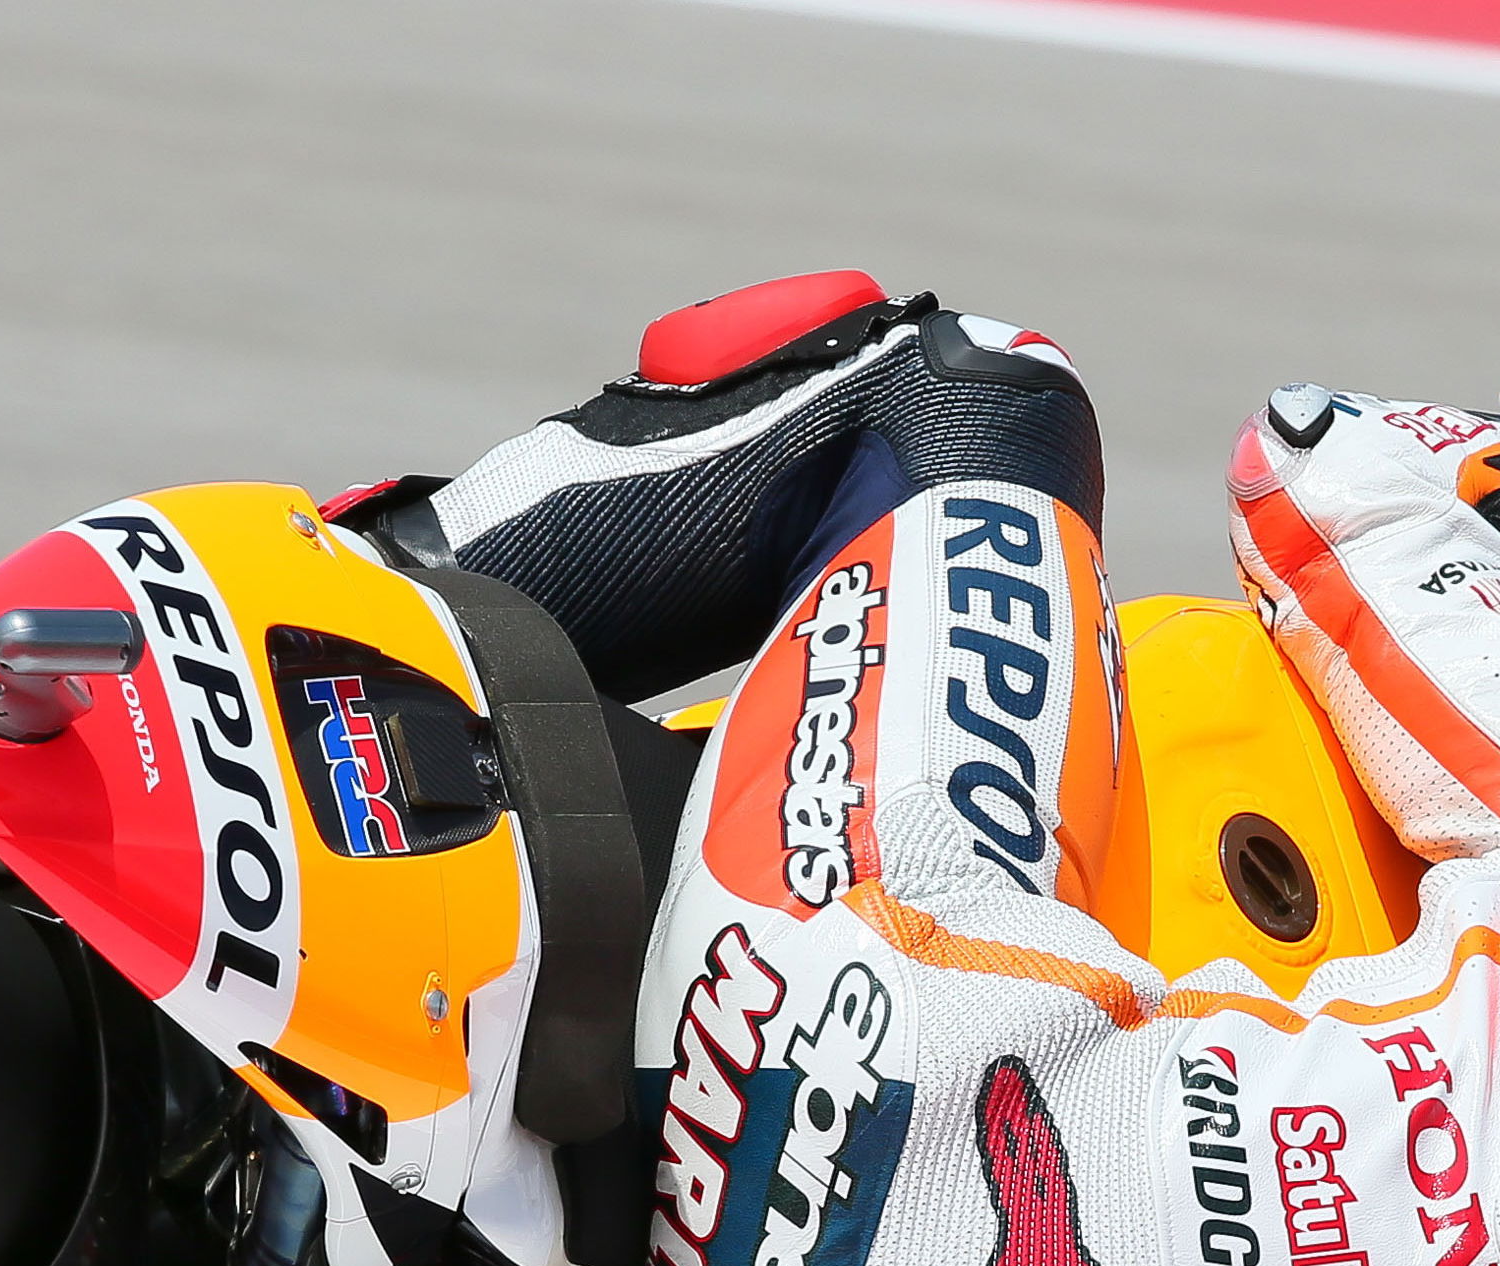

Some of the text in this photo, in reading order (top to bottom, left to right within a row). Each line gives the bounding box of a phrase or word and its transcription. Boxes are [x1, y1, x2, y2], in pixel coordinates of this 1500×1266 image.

[80, 514, 286, 996] REPSOL
[304, 674, 412, 858] HRC
[780, 562, 891, 909] alpinestars
